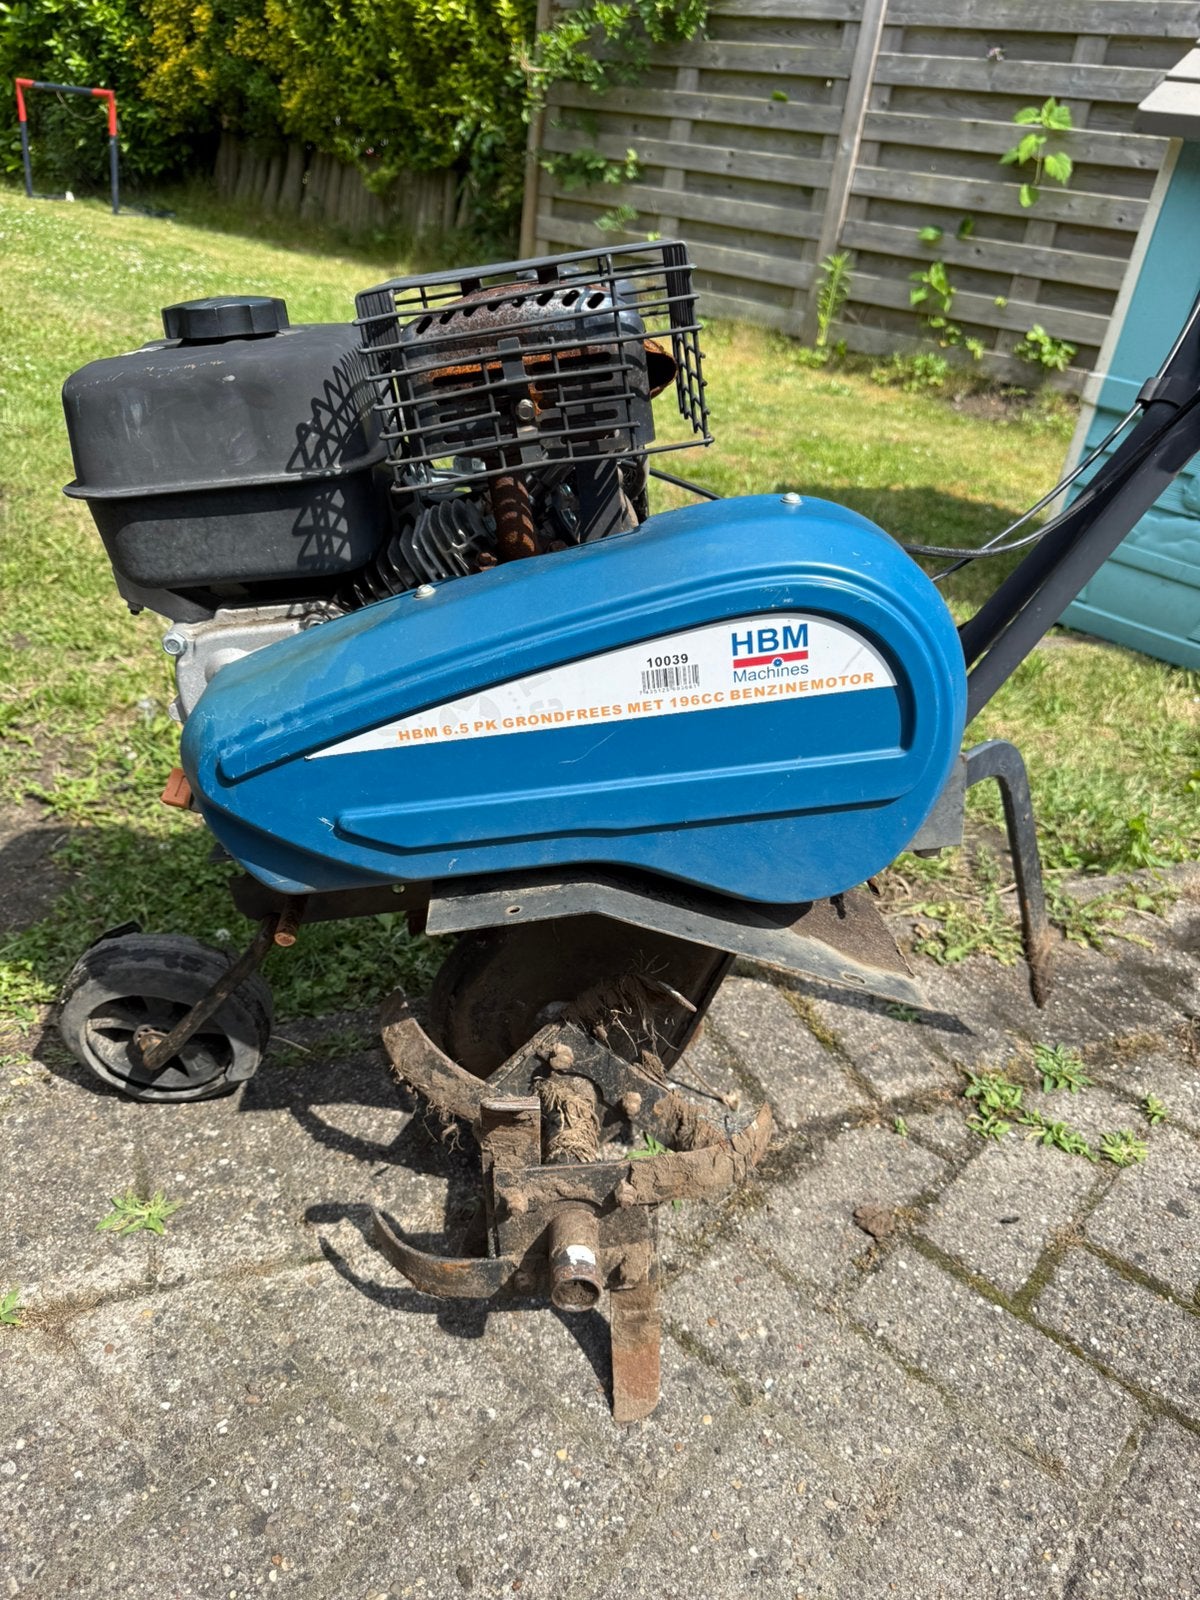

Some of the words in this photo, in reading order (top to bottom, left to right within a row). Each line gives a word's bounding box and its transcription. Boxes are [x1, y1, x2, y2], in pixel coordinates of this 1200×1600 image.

[731, 623, 809, 657] HBM
[646, 653, 689, 668] 10039
[733, 664, 809, 683] Machines
[398, 726, 438, 741] HBM
[442, 724, 469, 736] 6.5
[474, 719, 499, 732] PK
[502, 704, 623, 729] GRONDFREES
[627, 699, 664, 713] MET
[670, 692, 724, 709] 196CC
[730, 672, 875, 699] BENZINEMOTOR
